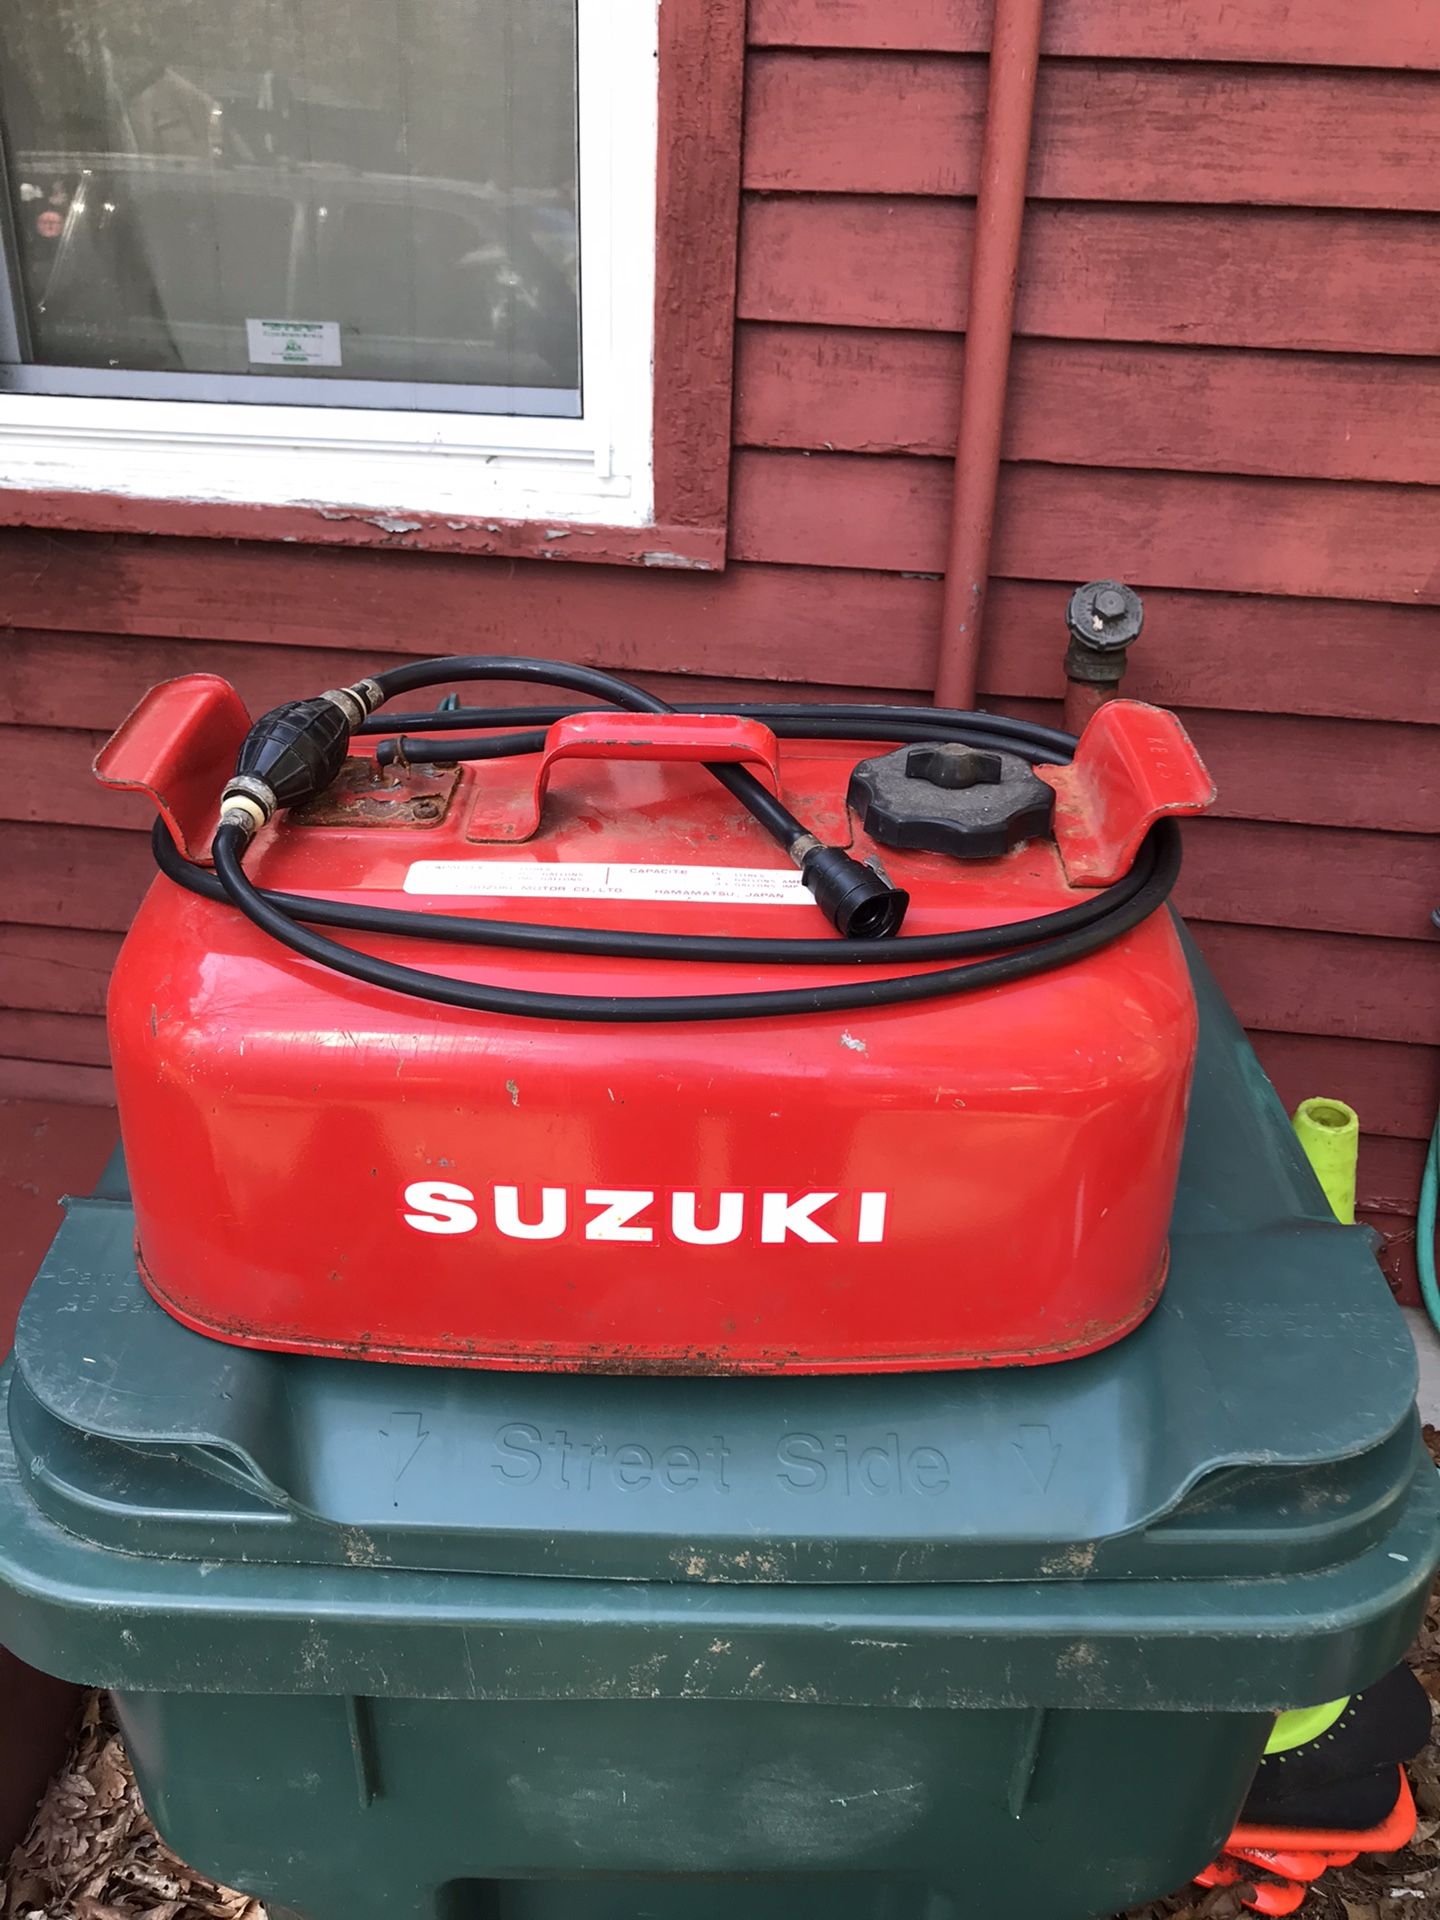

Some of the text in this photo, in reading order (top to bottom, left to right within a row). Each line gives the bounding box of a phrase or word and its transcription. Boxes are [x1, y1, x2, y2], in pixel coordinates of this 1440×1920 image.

[744, 892, 785, 900] JAPAN
[403, 1180, 888, 1245] SUZUKI
[490, 1421, 951, 1498] Street Side
